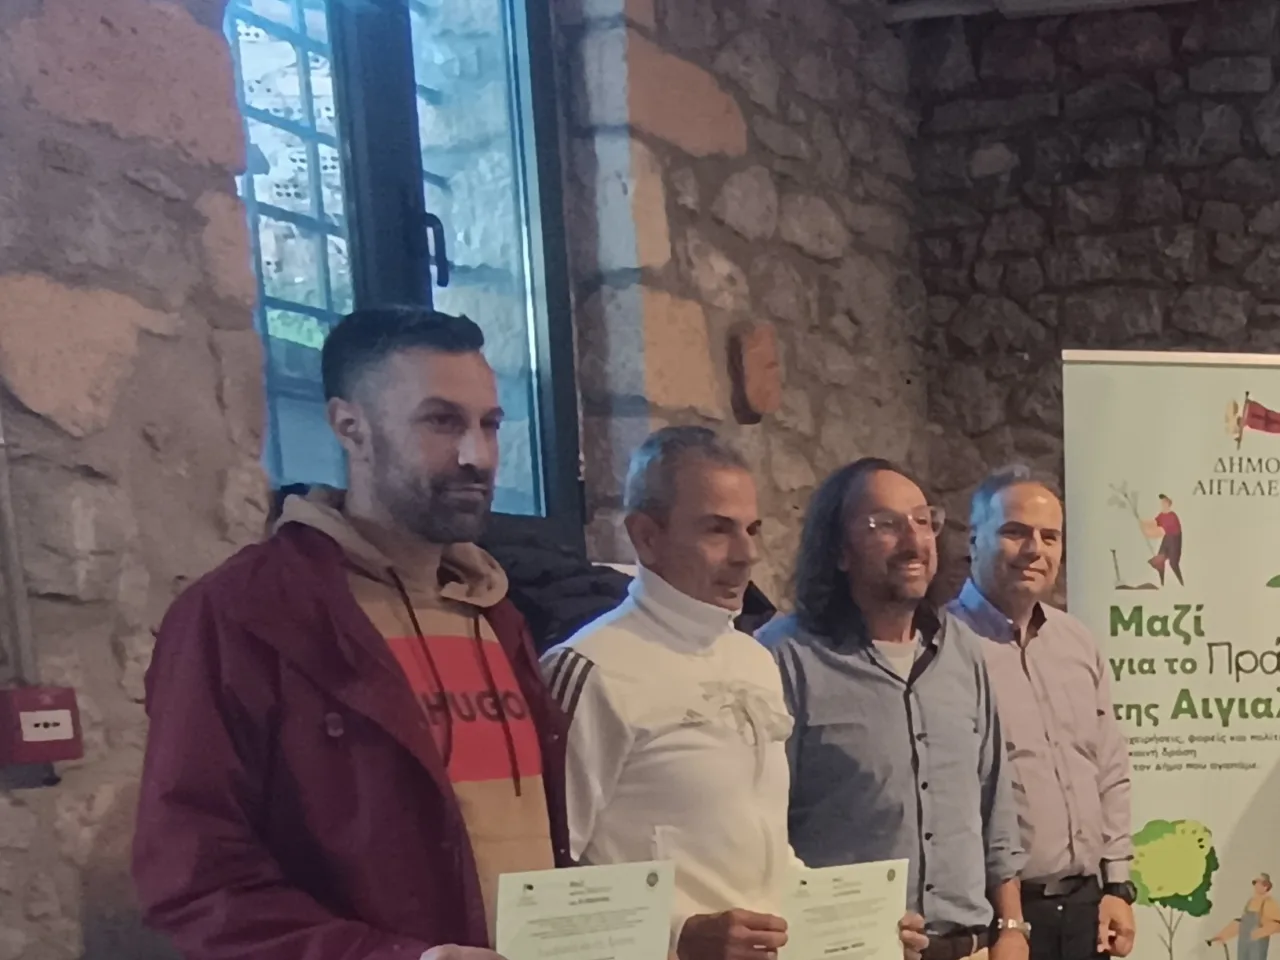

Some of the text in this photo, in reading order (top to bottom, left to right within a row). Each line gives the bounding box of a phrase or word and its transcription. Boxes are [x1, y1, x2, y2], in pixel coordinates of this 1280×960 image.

[1109, 604, 1205, 646] Μαζί
[1109, 658, 1156, 682] για
[1164, 658, 1197, 675] το
[421, 689, 527, 725] HUGO
[1112, 703, 1159, 727] της
